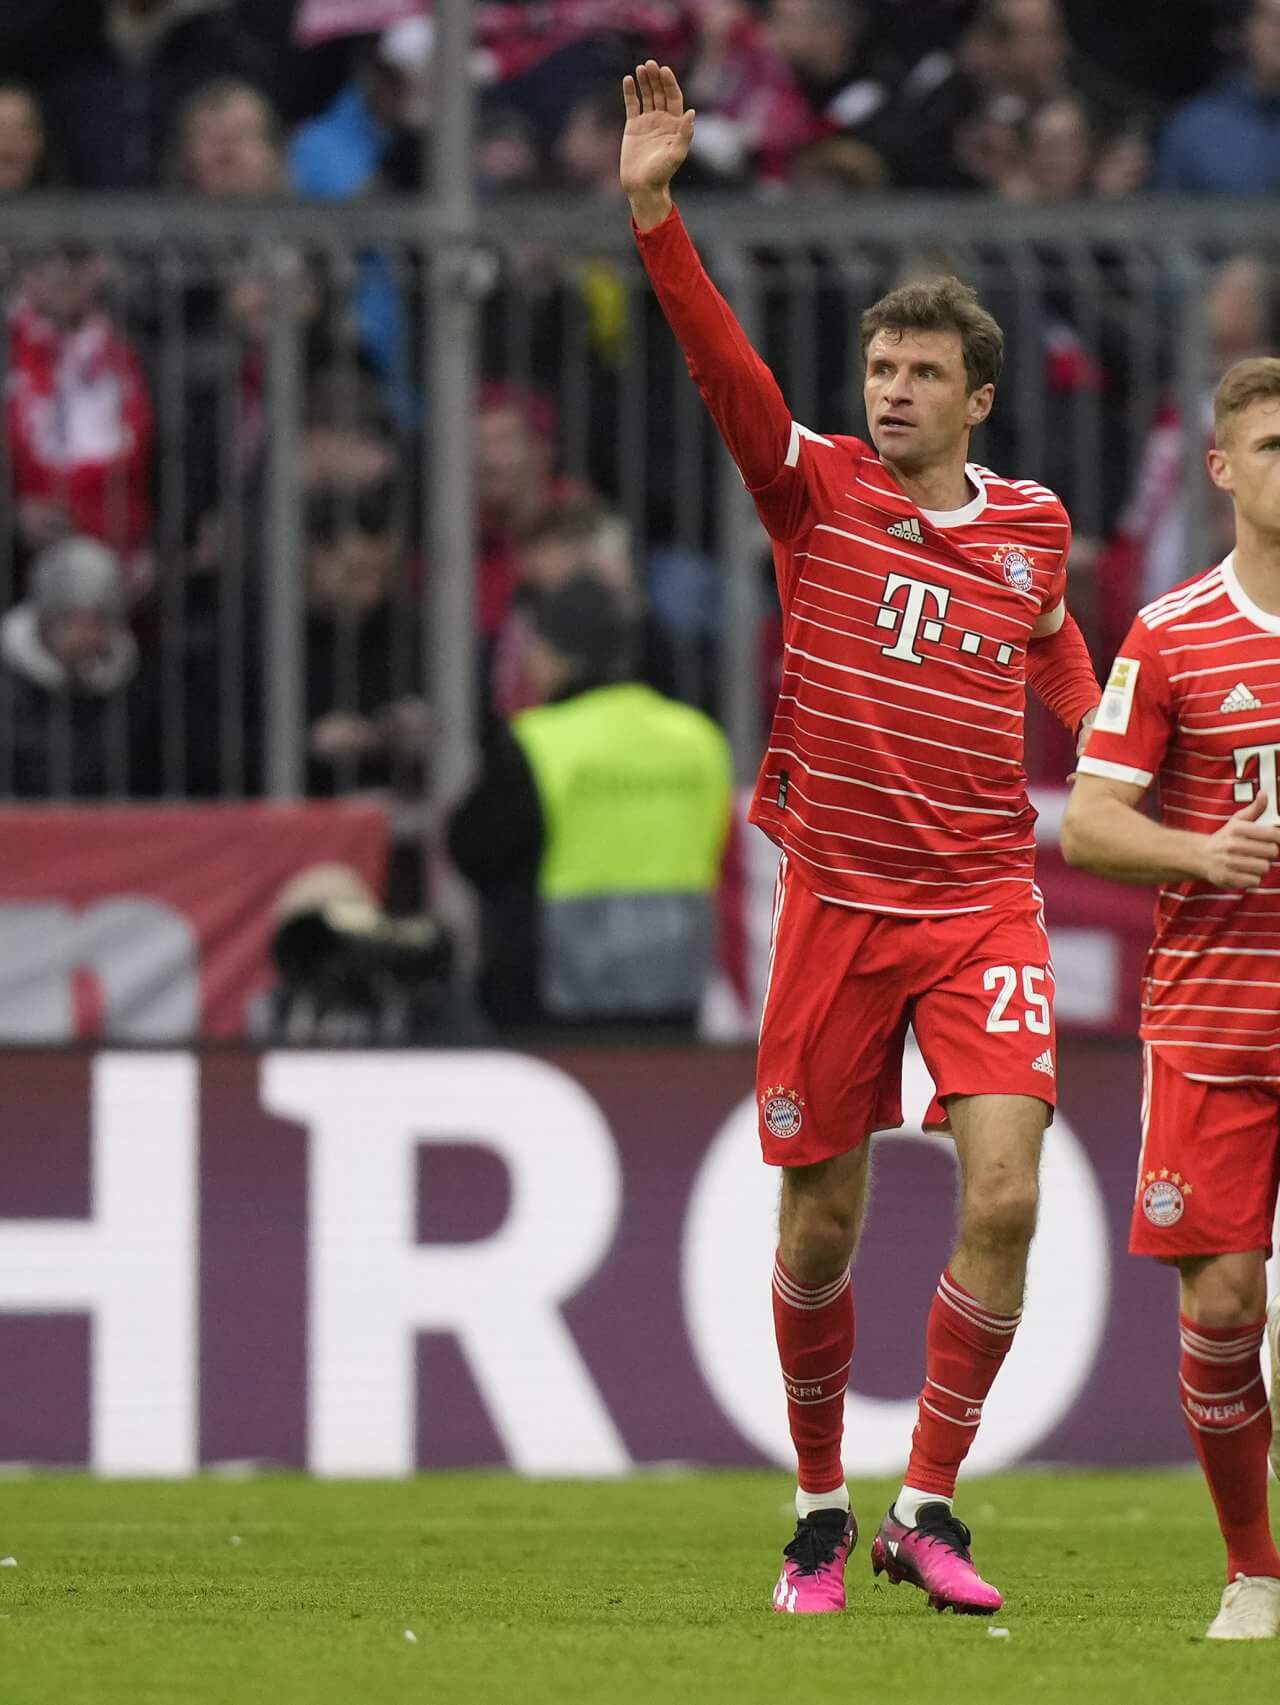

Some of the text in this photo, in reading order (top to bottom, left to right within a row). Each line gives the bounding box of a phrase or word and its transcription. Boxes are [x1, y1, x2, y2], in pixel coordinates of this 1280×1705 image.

[887, 526, 924, 544] adidas
[1220, 699, 1262, 714] adidas
[983, 965, 1051, 1036] 25
[785, 1382, 822, 1397] YERN
[1187, 1397, 1245, 1421] BAYERN
